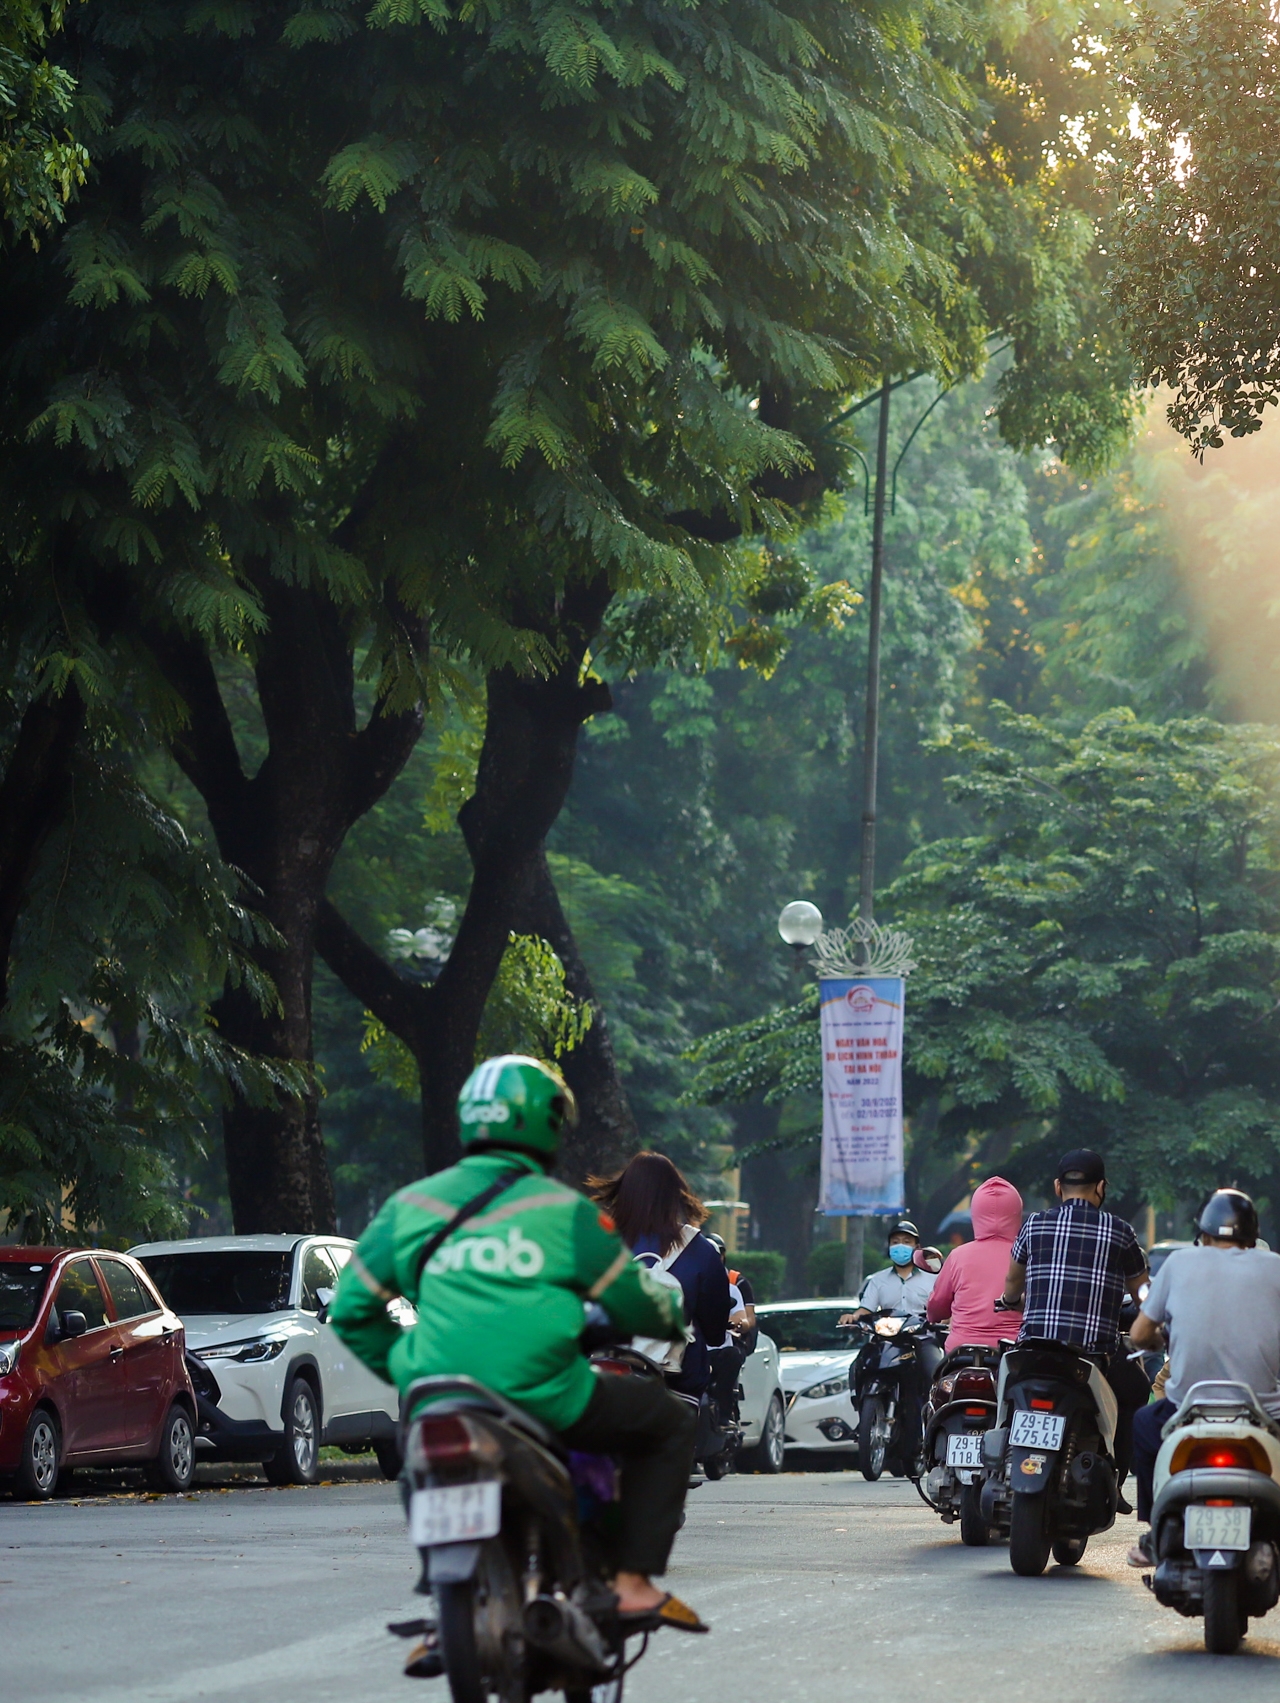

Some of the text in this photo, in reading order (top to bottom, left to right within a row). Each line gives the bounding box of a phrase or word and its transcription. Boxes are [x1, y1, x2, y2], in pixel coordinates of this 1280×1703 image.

[460, 1100, 510, 1125] Grab
[1020, 1413, 1058, 1432] 29-E1
[1013, 1429, 1060, 1449] 475.45
[1195, 1508, 1242, 1527] 29-S8
[1195, 1528, 1241, 1546] 8727
